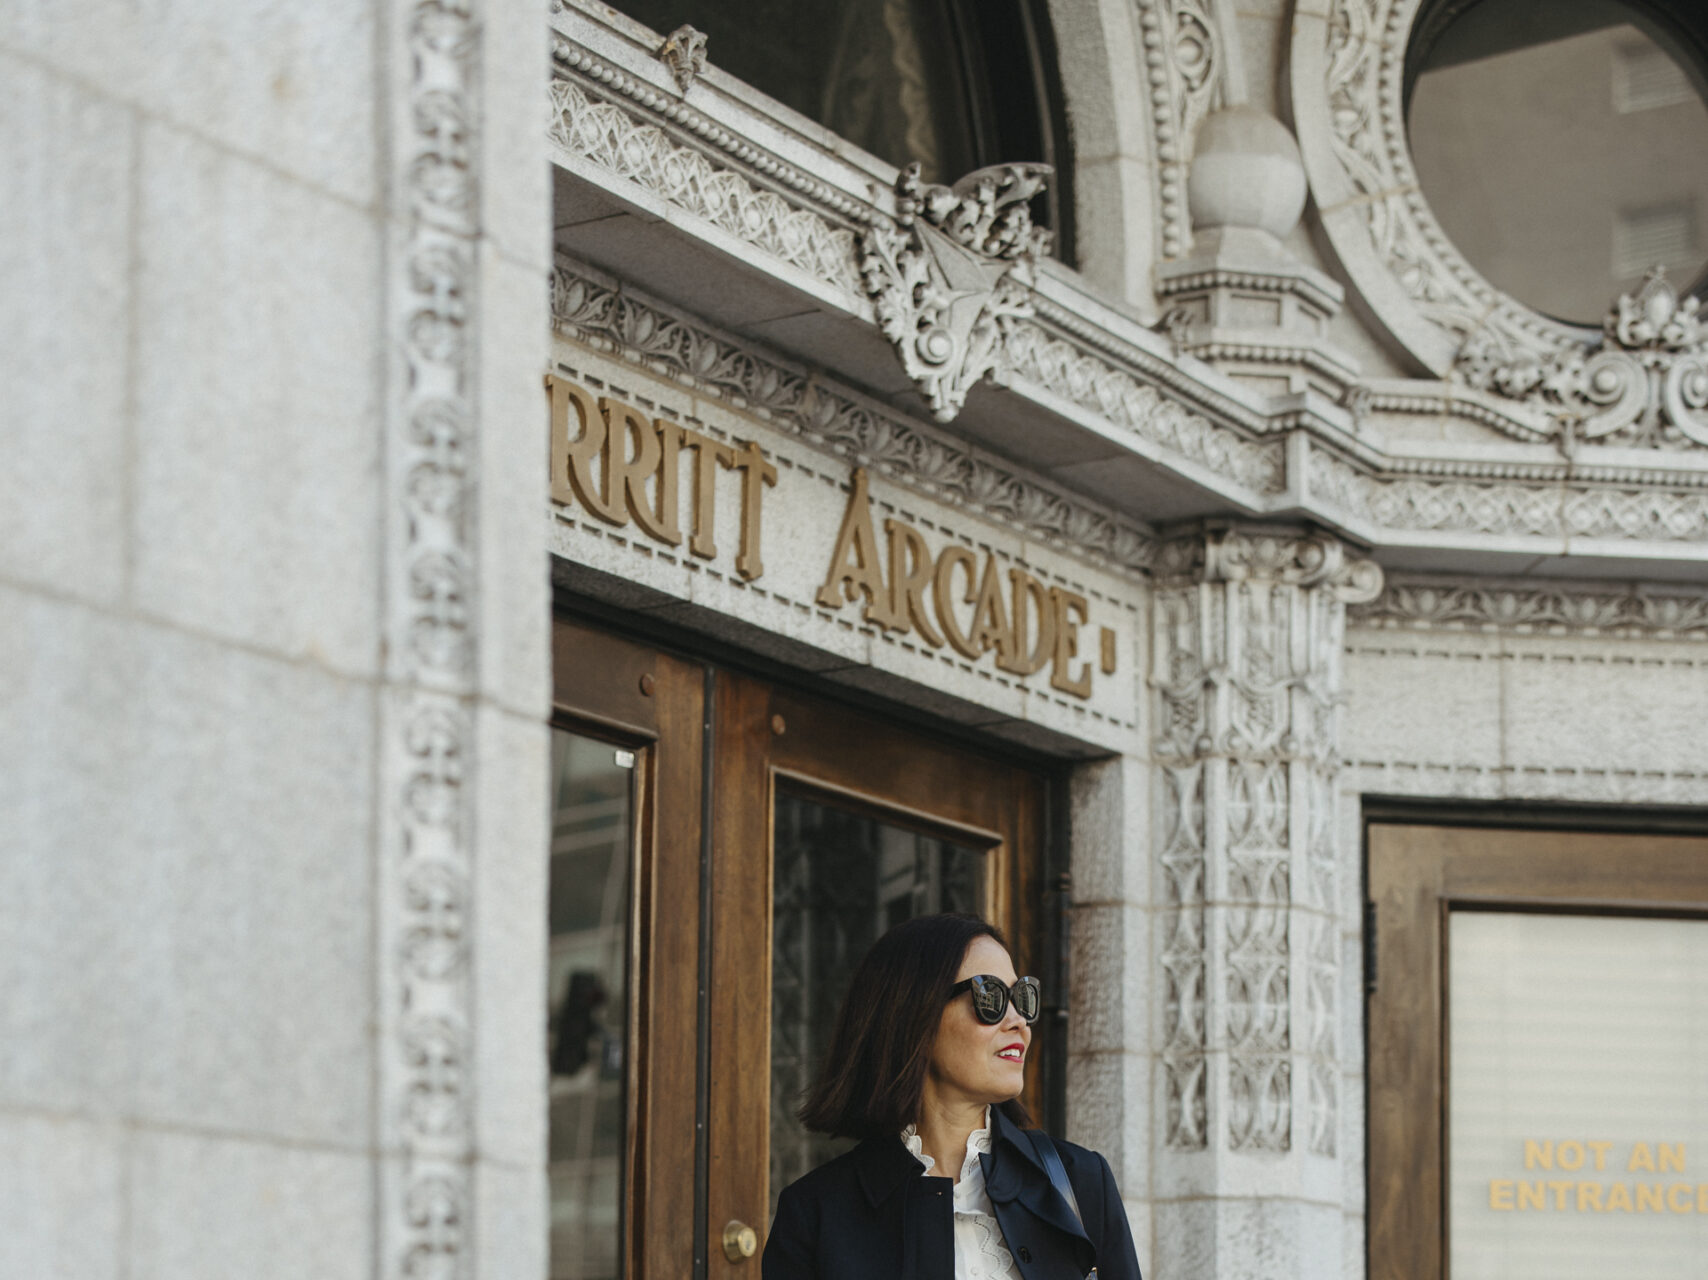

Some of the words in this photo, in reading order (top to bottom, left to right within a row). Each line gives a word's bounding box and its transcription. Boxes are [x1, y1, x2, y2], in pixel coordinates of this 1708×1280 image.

[816, 467, 1092, 700] ARCADE
[1524, 1140, 1613, 1171] NOT
[1627, 1140, 1686, 1173] AN
